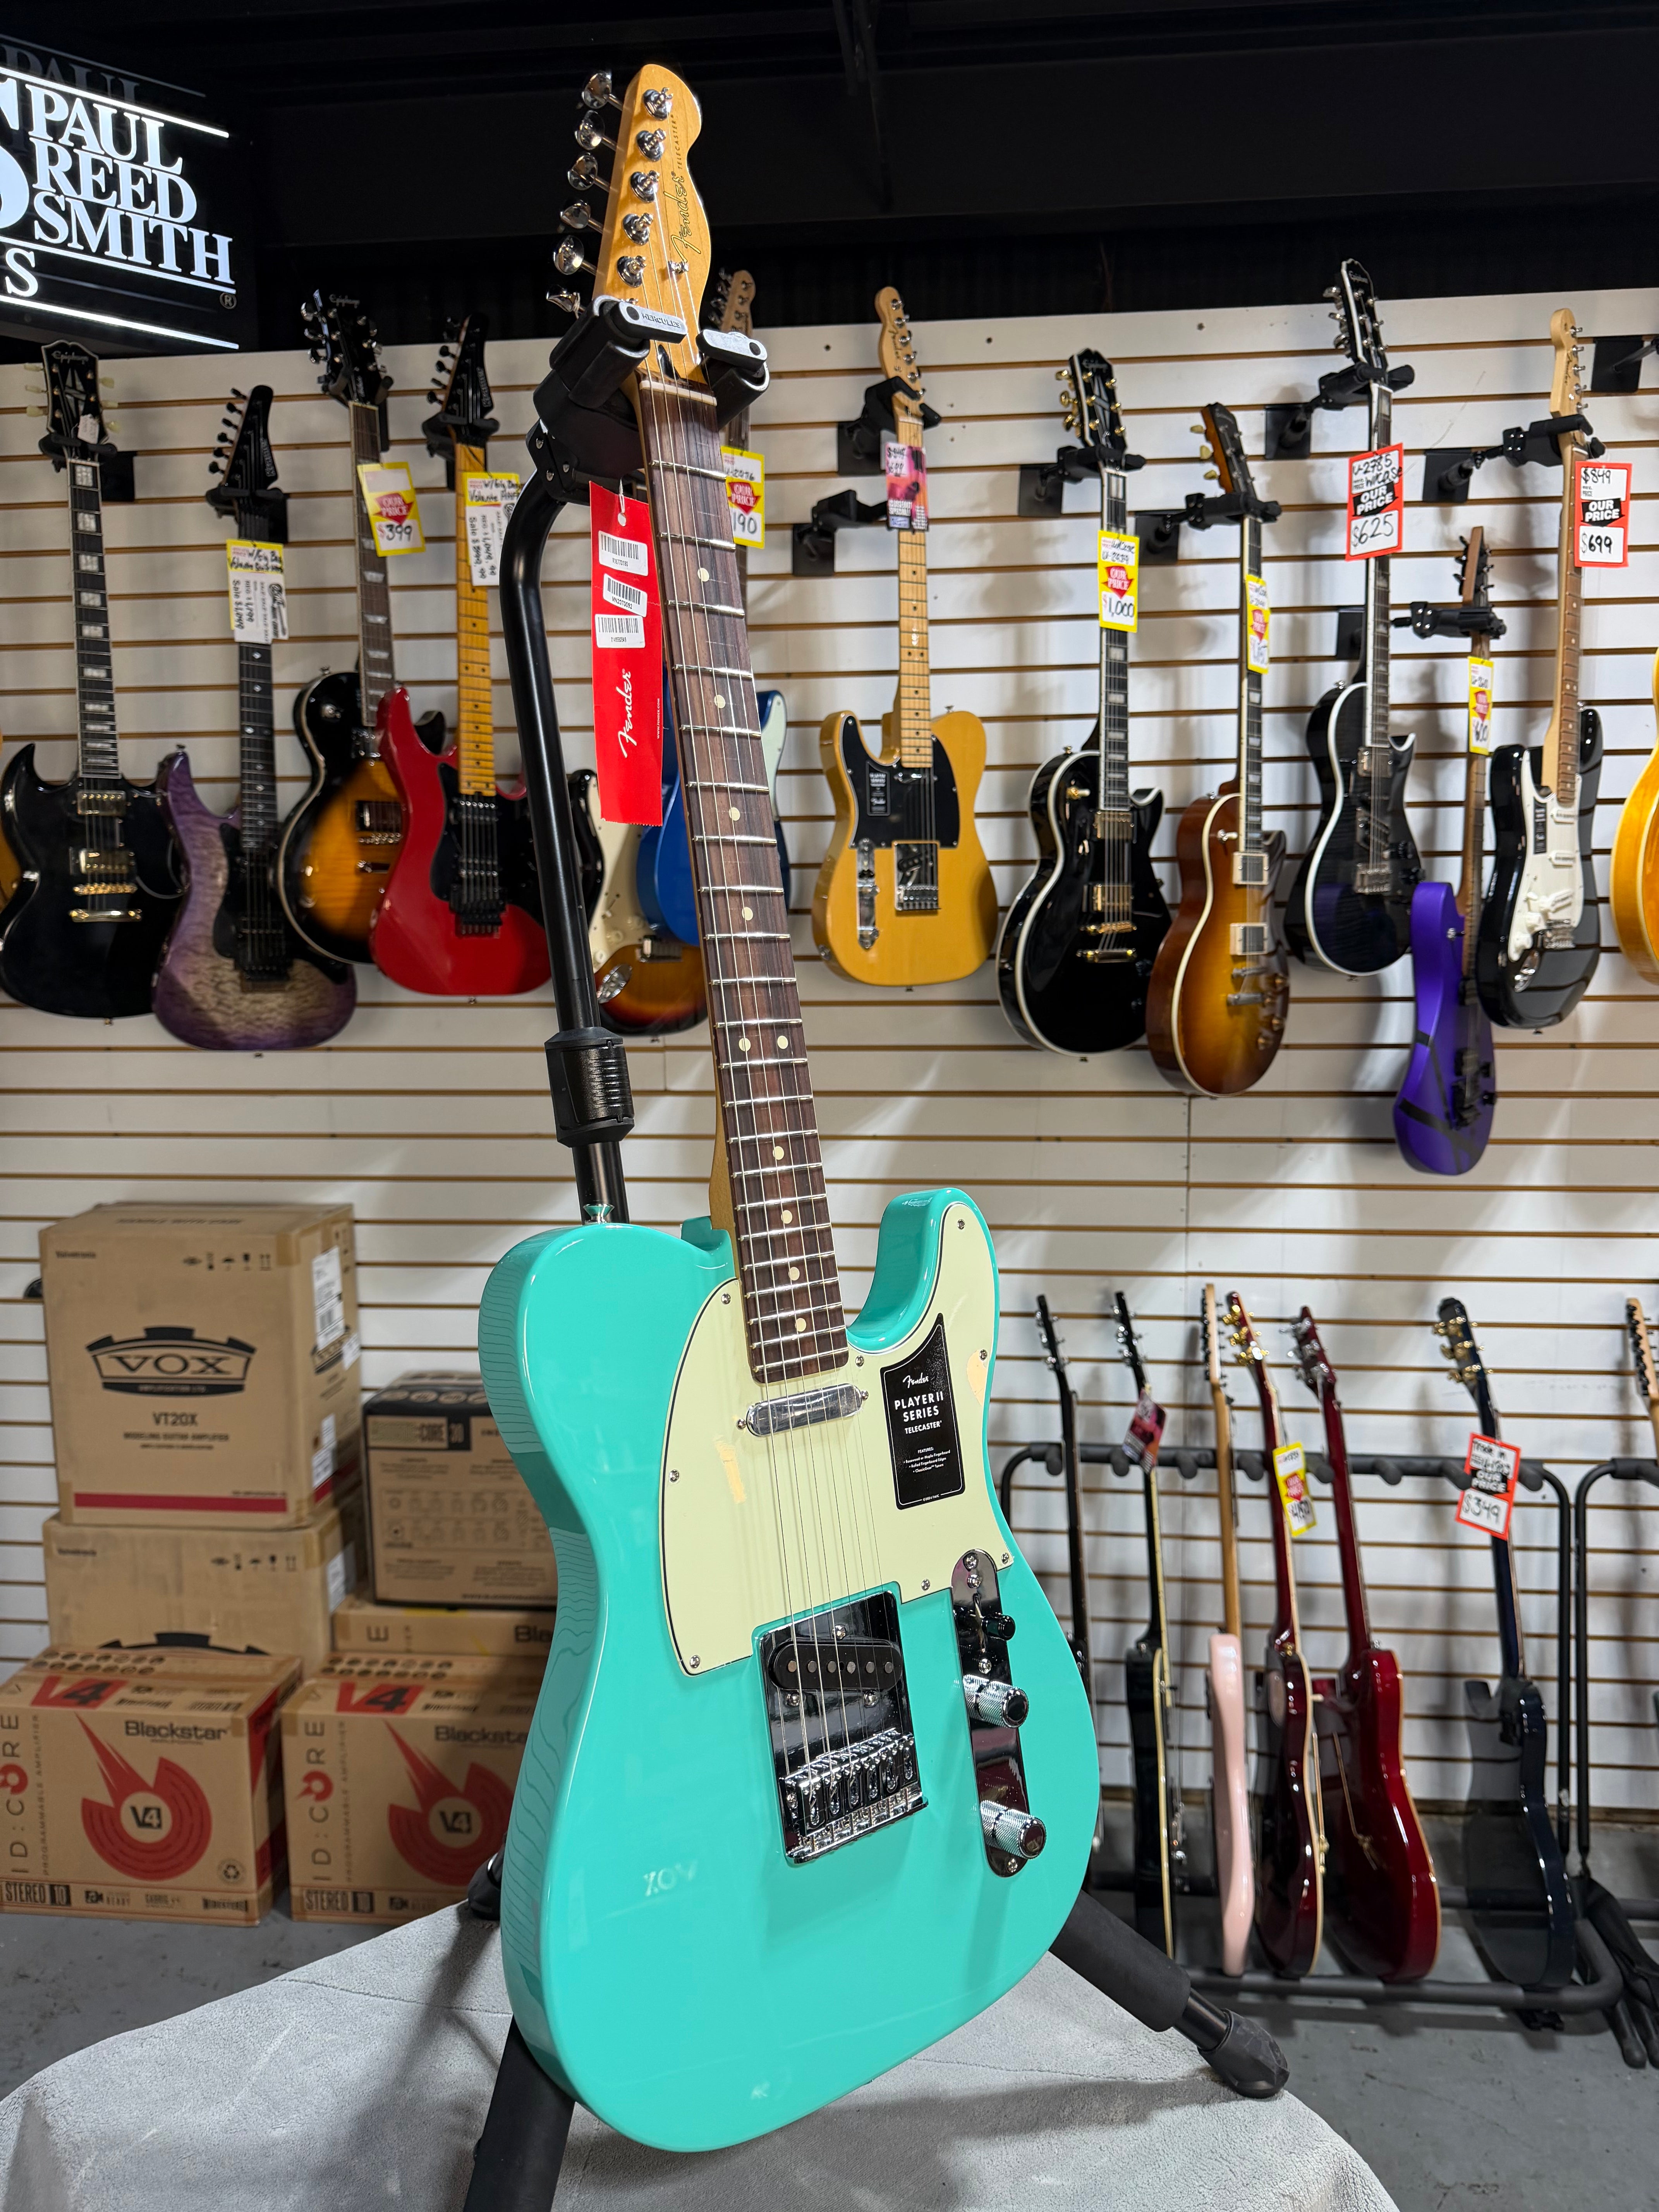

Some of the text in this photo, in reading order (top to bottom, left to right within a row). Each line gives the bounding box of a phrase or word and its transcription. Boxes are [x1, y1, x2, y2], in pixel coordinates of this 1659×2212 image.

[25, 83, 183, 175] PAUL
[672, 120, 682, 170] TELECASTER
[29, 137, 198, 224] REED
[663, 175, 701, 263] Fender
[34, 191, 235, 285] SMITH
[641, 313, 680, 328] HERCULES
[1581, 467, 1611, 484] $849
[733, 484, 753, 496] OUR
[1360, 485, 1388, 503] OUR
[382, 496, 404, 507] OUR
[732, 493, 756, 507] PRICE
[1357, 492, 1394, 515] PRICE
[1589, 500, 1614, 512] OUR
[381, 505, 409, 517] PRICE
[1584, 508, 1620, 522] PRICE
[377, 524, 412, 541] $399
[1352, 514, 1394, 548] $625
[1581, 532, 1613, 555] $699
[1110, 567, 1127, 580] OUR
[1108, 577, 1129, 591] PRICE
[616, 669, 637, 759] Fender
[108, 1353, 234, 1375] VOX
[902, 1372, 929, 1389] Fender
[894, 1391, 944, 1410] PLAYER II
[152, 1412, 199, 1427] VT20X
[903, 1405, 939, 1422] SERIES
[904, 1420, 942, 1434] TELECASTER
[1472, 1477, 1507, 1493] PRICE
[1476, 1470, 1502, 1483] OUR
[1462, 1494, 1500, 1523] $349
[29, 1675, 129, 1710] V4
[337, 1682, 424, 1715] V4
[124, 1720, 228, 1741] Blackstar
[434, 1725, 529, 1742] Blacksta
[130, 1805, 163, 1830] V4
[439, 1811, 472, 1834] V4
[5, 1882, 46, 1904] STEREO
